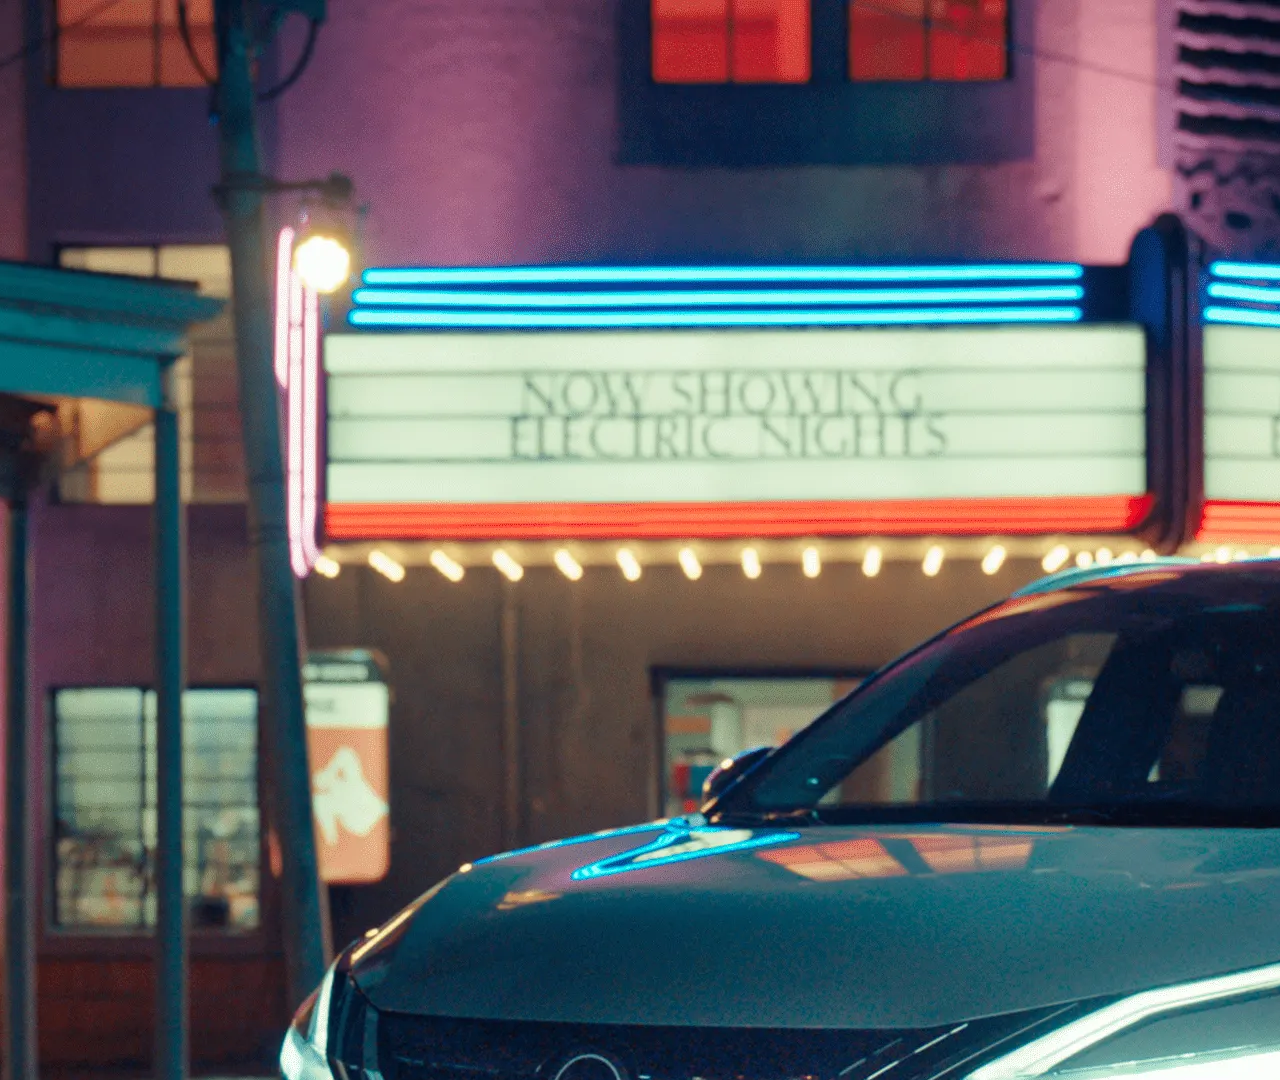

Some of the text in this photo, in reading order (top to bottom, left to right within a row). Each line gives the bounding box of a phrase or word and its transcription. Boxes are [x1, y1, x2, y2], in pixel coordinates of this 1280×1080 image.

[521, 369, 924, 417] NOW SHOWING
[510, 413, 950, 459] ELECTRIC NIGHTS
